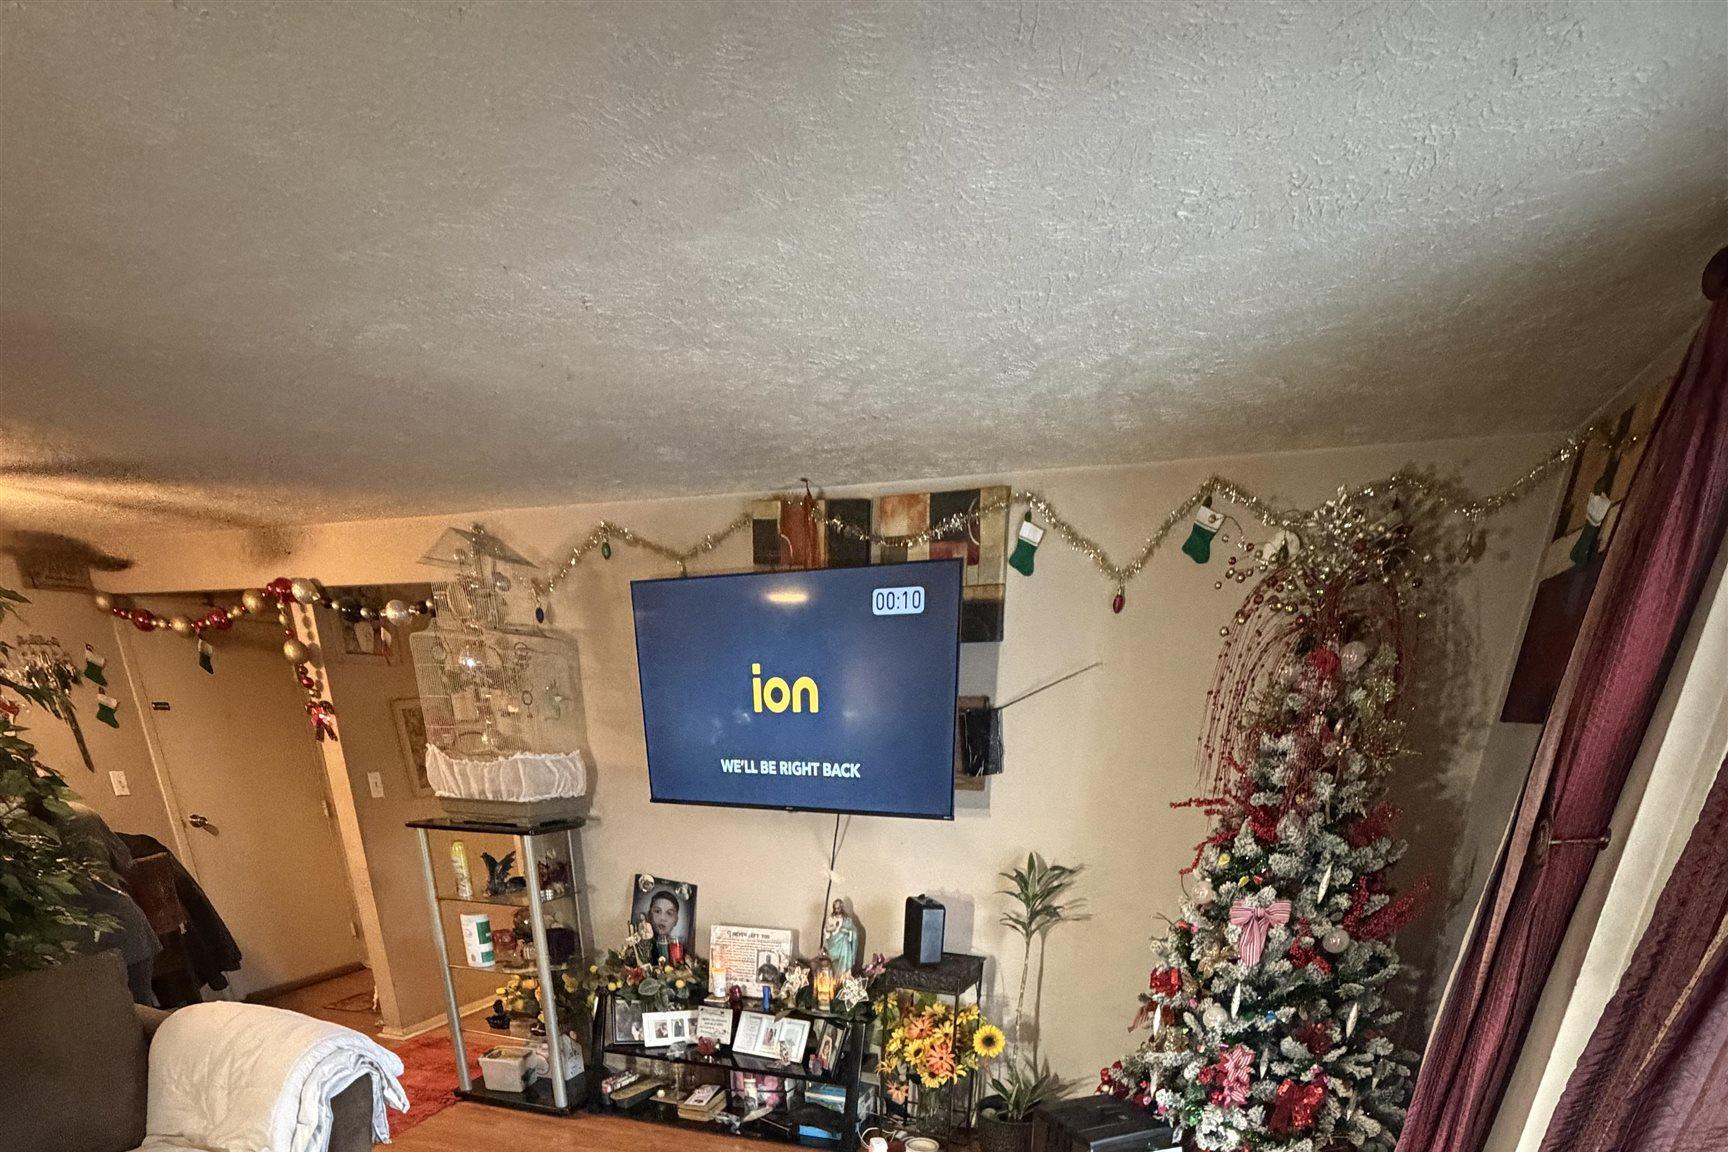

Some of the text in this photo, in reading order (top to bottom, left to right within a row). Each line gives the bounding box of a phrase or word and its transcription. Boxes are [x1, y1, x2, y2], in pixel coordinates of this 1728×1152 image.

[875, 590, 922, 611] 00:10
[751, 662, 820, 714] ion
[720, 758, 861, 779] WE'LL BE RIGHT BACK
